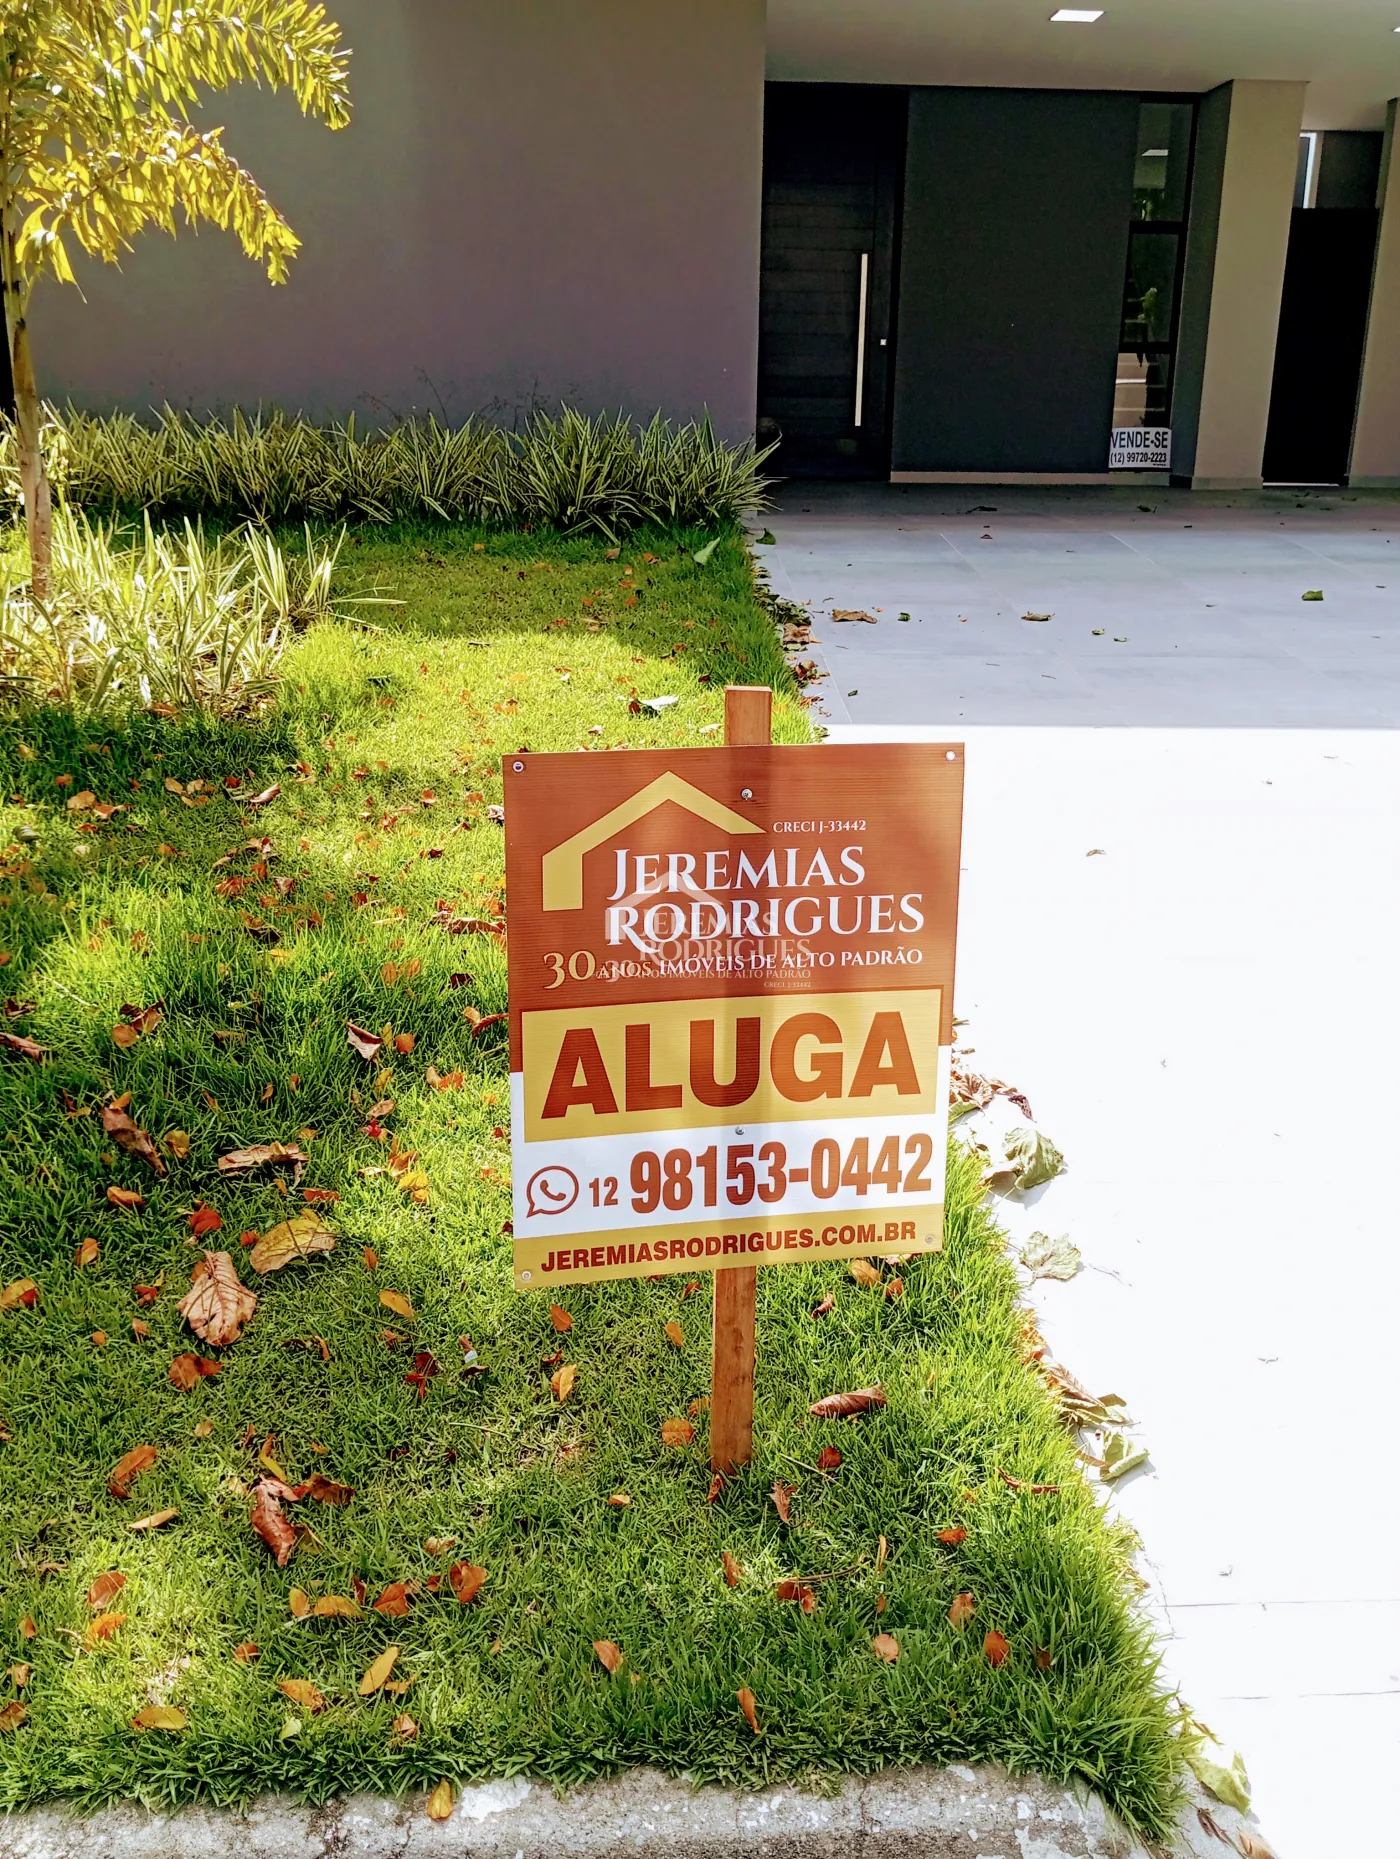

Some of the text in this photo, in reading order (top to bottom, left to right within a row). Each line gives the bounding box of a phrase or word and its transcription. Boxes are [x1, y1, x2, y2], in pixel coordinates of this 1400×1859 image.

[1110, 452, 1167, 465] (12) 99720-2223
[1111, 431, 1168, 448] VENDE-SE
[773, 820, 867, 834] CRECI J-33442
[607, 846, 866, 900] JEREMIAS
[606, 894, 925, 954] RODRIGUES
[543, 950, 596, 989] 30
[597, 961, 652, 979] ANOS
[660, 954, 744, 975] IMÓVEIS
[750, 954, 776, 970] DE
[781, 951, 835, 968] ALTO
[841, 946, 923, 966] PADRÃO
[541, 1011, 921, 1119] ALUGA
[588, 1133, 933, 1214] 12 98153-0442
[541, 1221, 916, 1272] JEREMIASRODRIGUES.COM.BR
